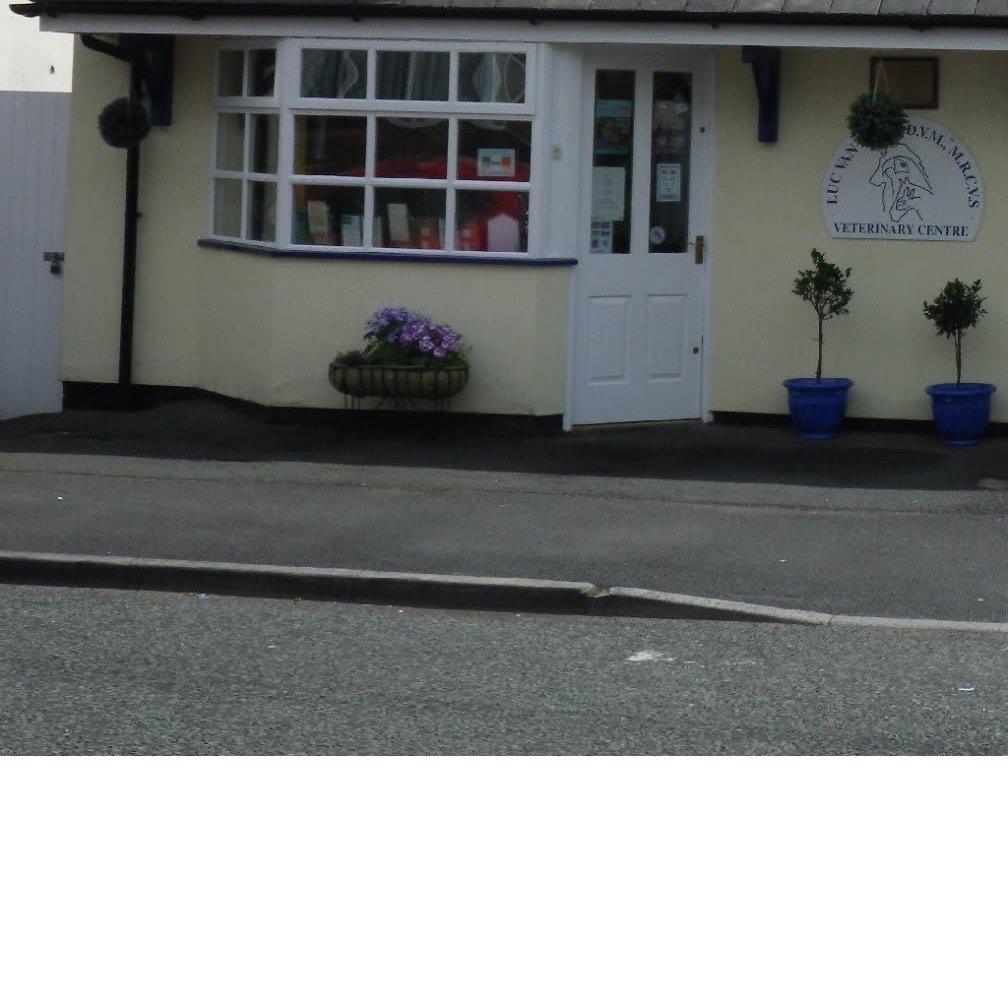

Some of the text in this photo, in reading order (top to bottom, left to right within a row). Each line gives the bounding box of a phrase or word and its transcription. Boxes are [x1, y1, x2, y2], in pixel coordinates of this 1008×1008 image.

[826, 172, 841, 204] LUC
[834, 222, 969, 237] VETERINARY CENTRE
